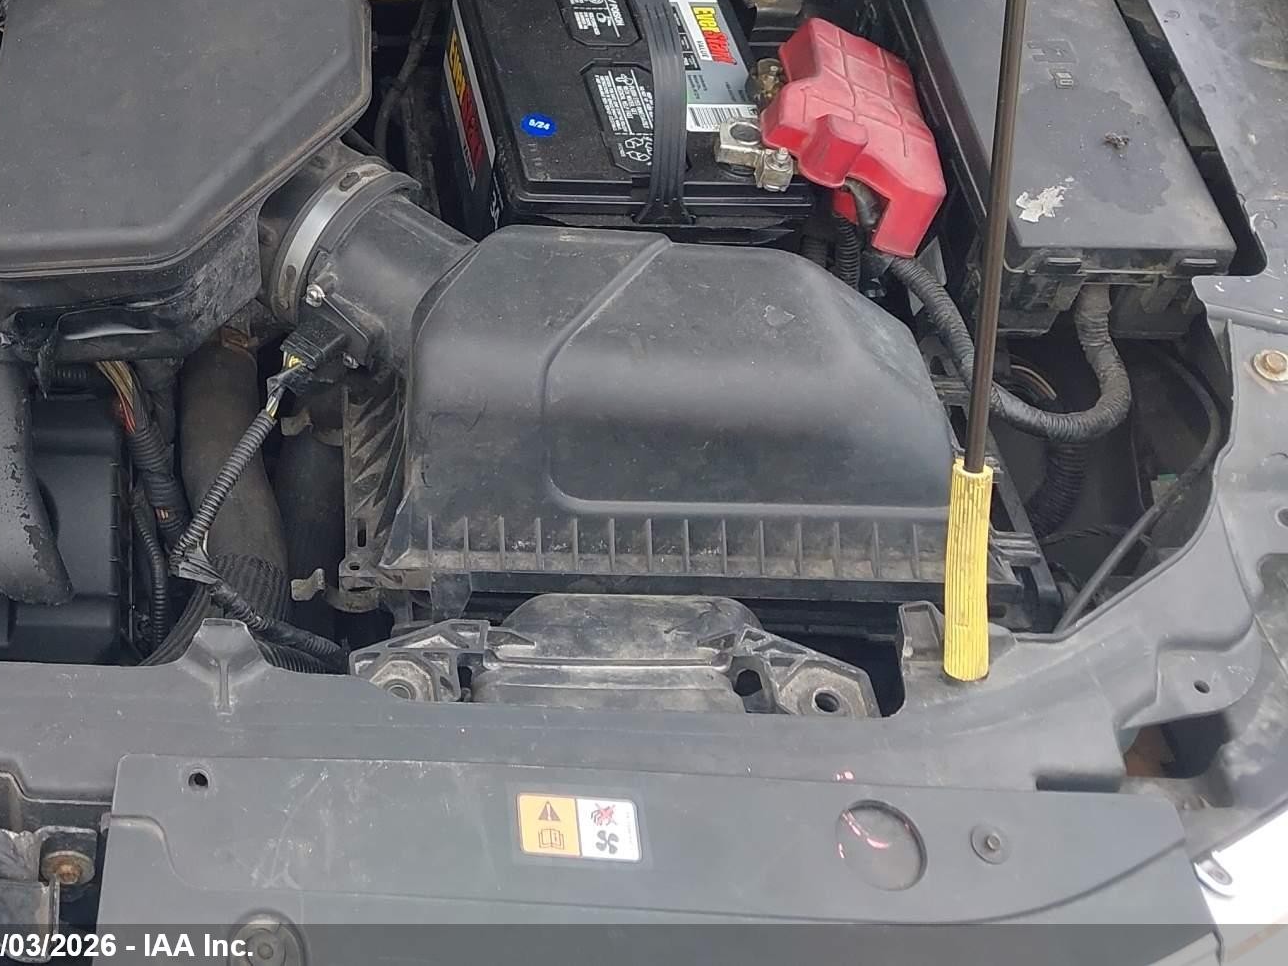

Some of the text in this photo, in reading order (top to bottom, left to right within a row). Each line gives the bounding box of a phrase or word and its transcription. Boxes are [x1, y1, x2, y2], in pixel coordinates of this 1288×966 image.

[609, 4, 625, 26] POISON
[693, 7, 737, 64] EverStart
[697, 40, 710, 58] VALUE
